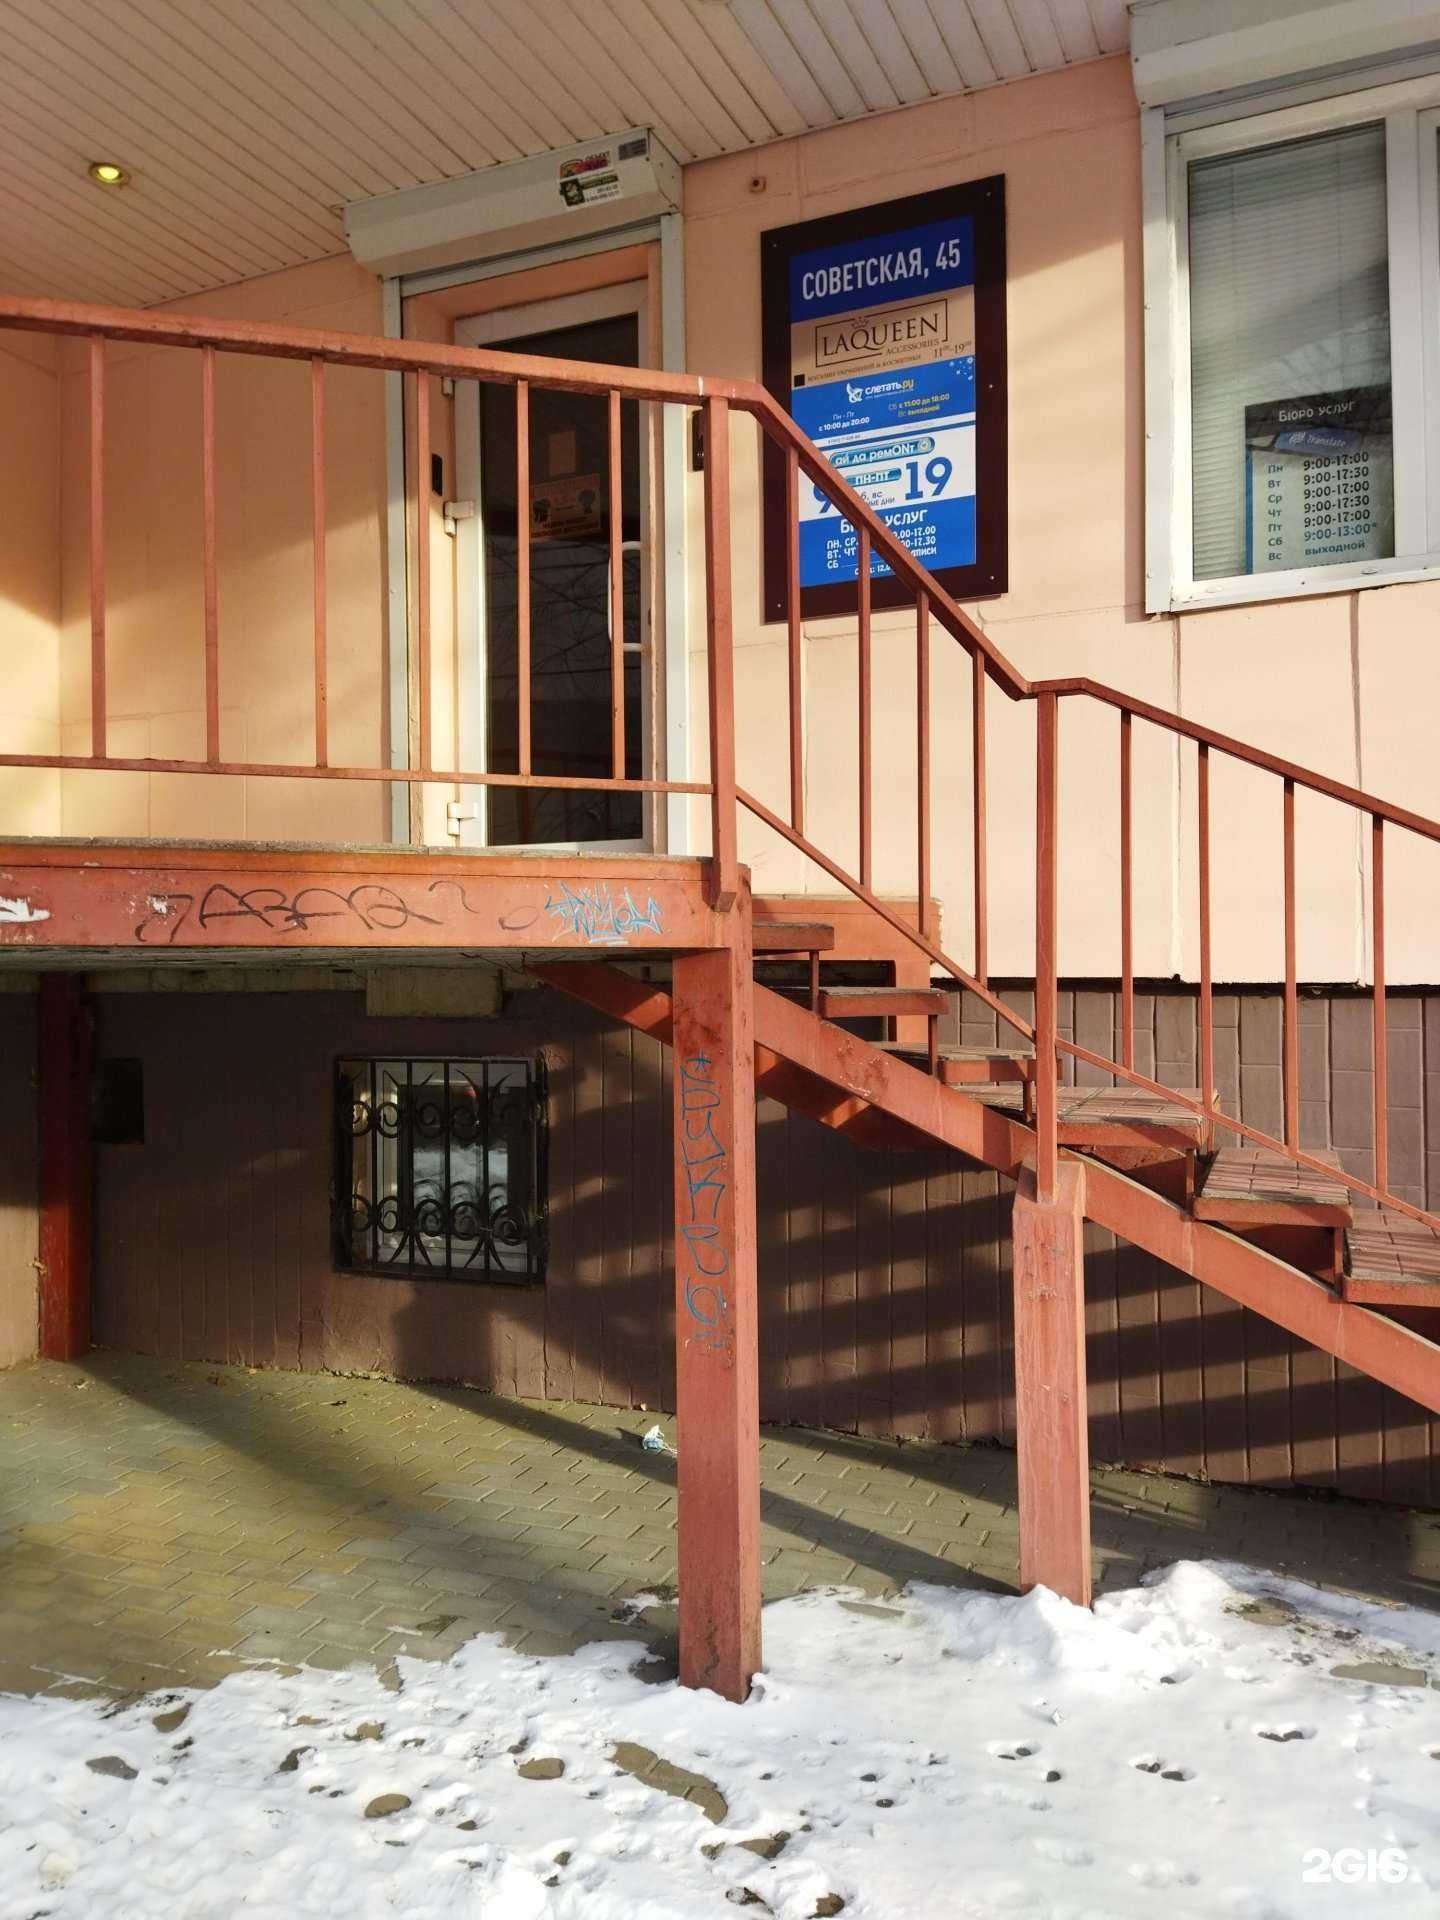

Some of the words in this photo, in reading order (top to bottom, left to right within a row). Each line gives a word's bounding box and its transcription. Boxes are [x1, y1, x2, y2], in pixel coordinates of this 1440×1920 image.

[802, 247, 929, 301] СОВЕТСКАЯ,
[935, 238, 961, 269] 45
[822, 312, 939, 357] LAQUEEN
[1318, 400, 1356, 417] услуг
[850, 416, 870, 426] 20:00
[852, 453, 867, 464] да
[1268, 464, 1284, 474] Пн
[1303, 451, 1369, 471] 9:00-17:00
[905, 456, 953, 501] 19
[1267, 480, 1282, 488] Вт
[1303, 466, 1369, 485] 9:00-17:30
[1268, 494, 1283, 505] Ср
[1303, 480, 1370, 500] 9:00-17:00
[1267, 508, 1283, 517] Чт
[1303, 494, 1370, 514] 9:00-17:30
[885, 509, 928, 527] УСЛУГ
[1268, 523, 1283, 532] Пт
[1303, 508, 1371, 528] 9:00-17:00
[826, 539, 842, 550] ПН.
[1268, 536, 1283, 546] Сб
[1268, 552, 1283, 561] Вс
[1304, 541, 1366, 556] выходной
[826, 550, 842, 560] ВТ.
[826, 560, 839, 570] СБ
